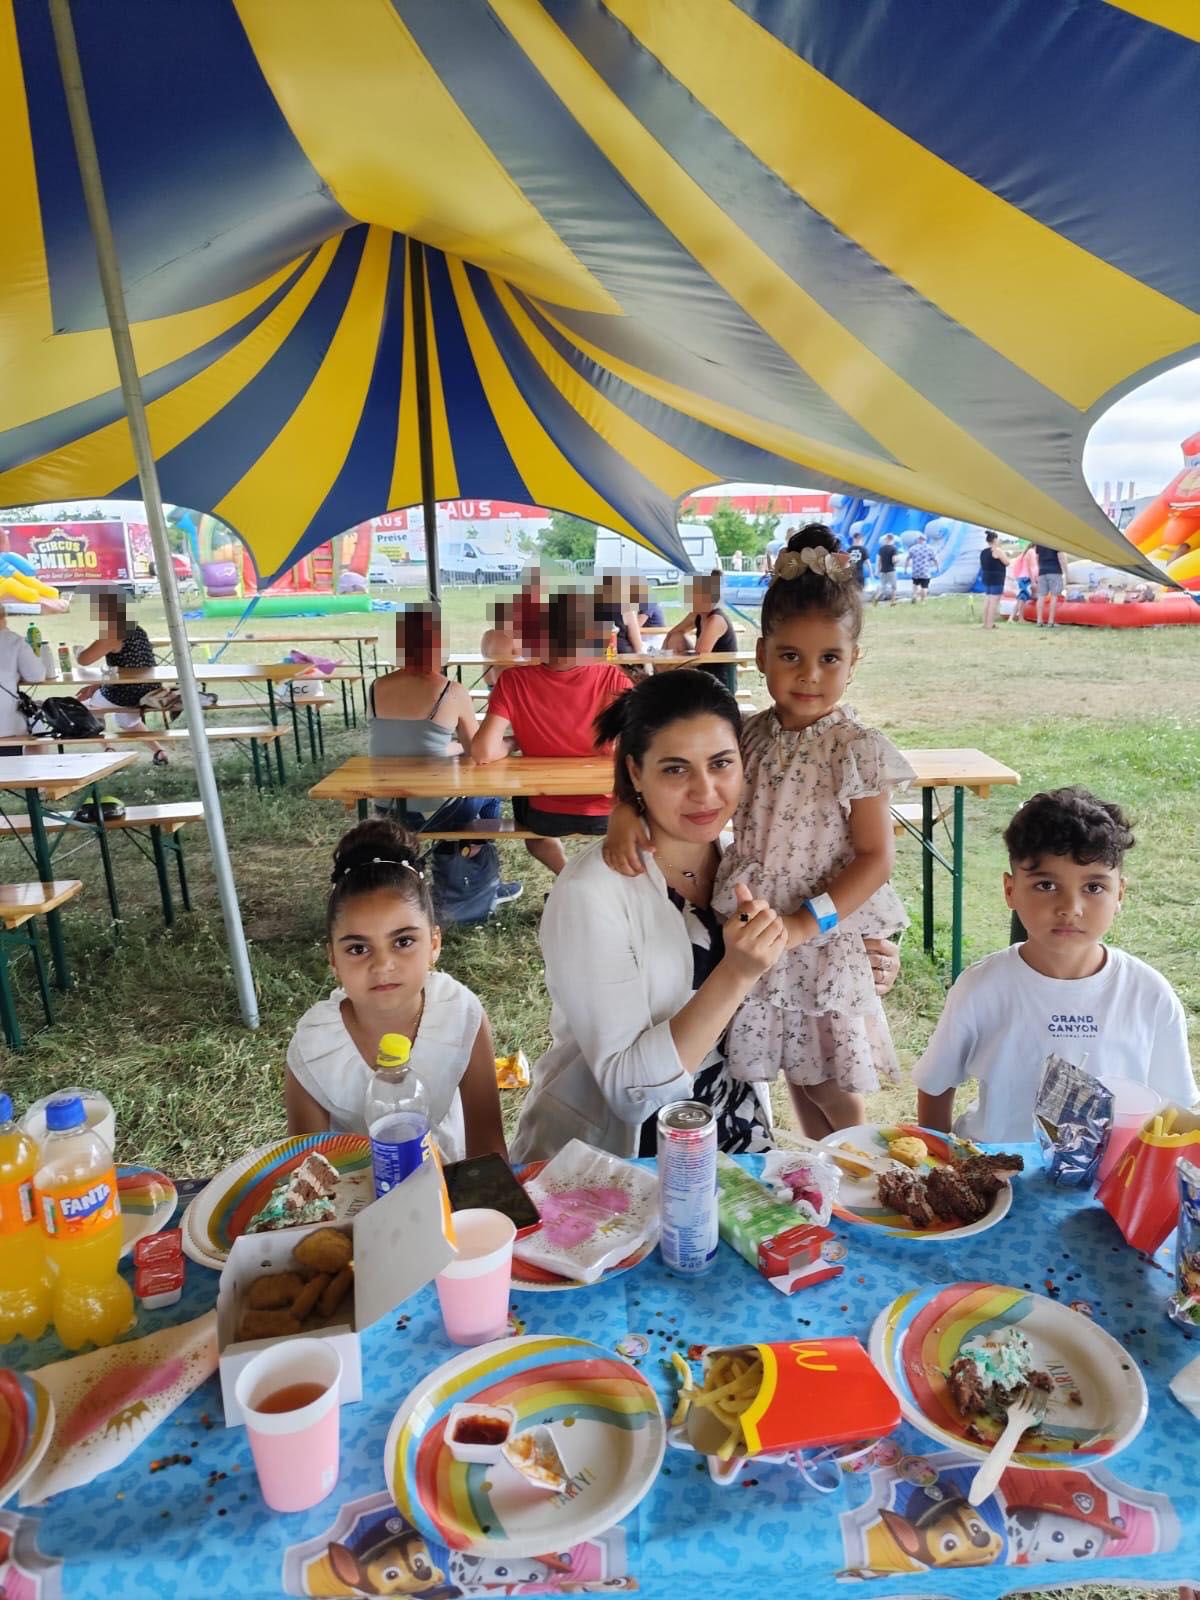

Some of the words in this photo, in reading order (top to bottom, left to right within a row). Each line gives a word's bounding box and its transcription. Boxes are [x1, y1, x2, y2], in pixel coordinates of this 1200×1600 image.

[448, 501, 492, 517] AUS
[377, 534, 408, 543] Preise
[38, 540, 81, 553] CIRCUS
[27, 551, 98, 569] EMILIO
[1051, 1014, 1094, 1023] GRAND
[1048, 1023, 1098, 1032] CANYON
